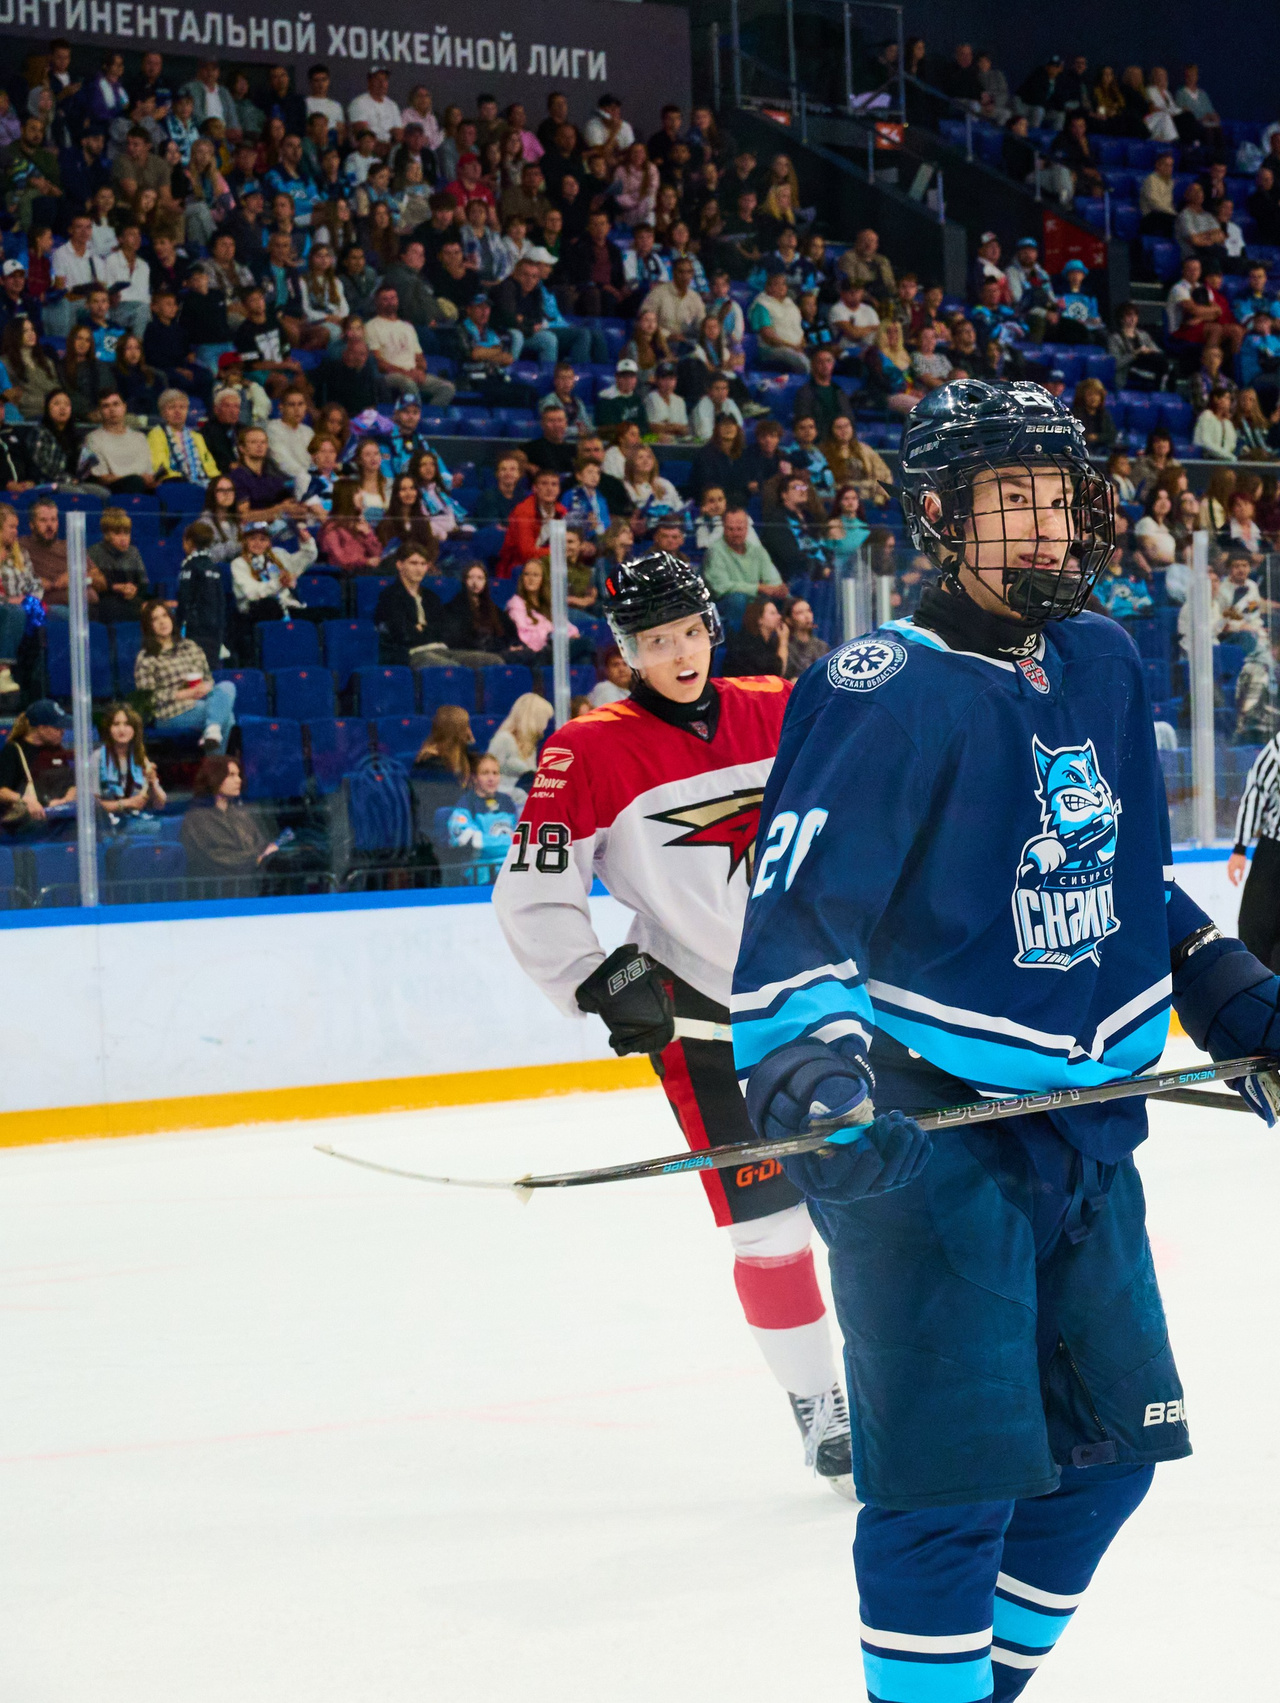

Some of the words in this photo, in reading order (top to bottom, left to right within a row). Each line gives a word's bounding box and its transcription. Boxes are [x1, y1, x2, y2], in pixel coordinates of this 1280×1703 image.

[328, 25, 518, 73] ХОККЕЙНОЙ
[528, 44, 608, 82] ЛИГИ
[866, 665, 897, 688] ОБЛАСТЬ
[509, 821, 571, 874] 18
[1178, 1069, 1216, 1084] NEXUS
